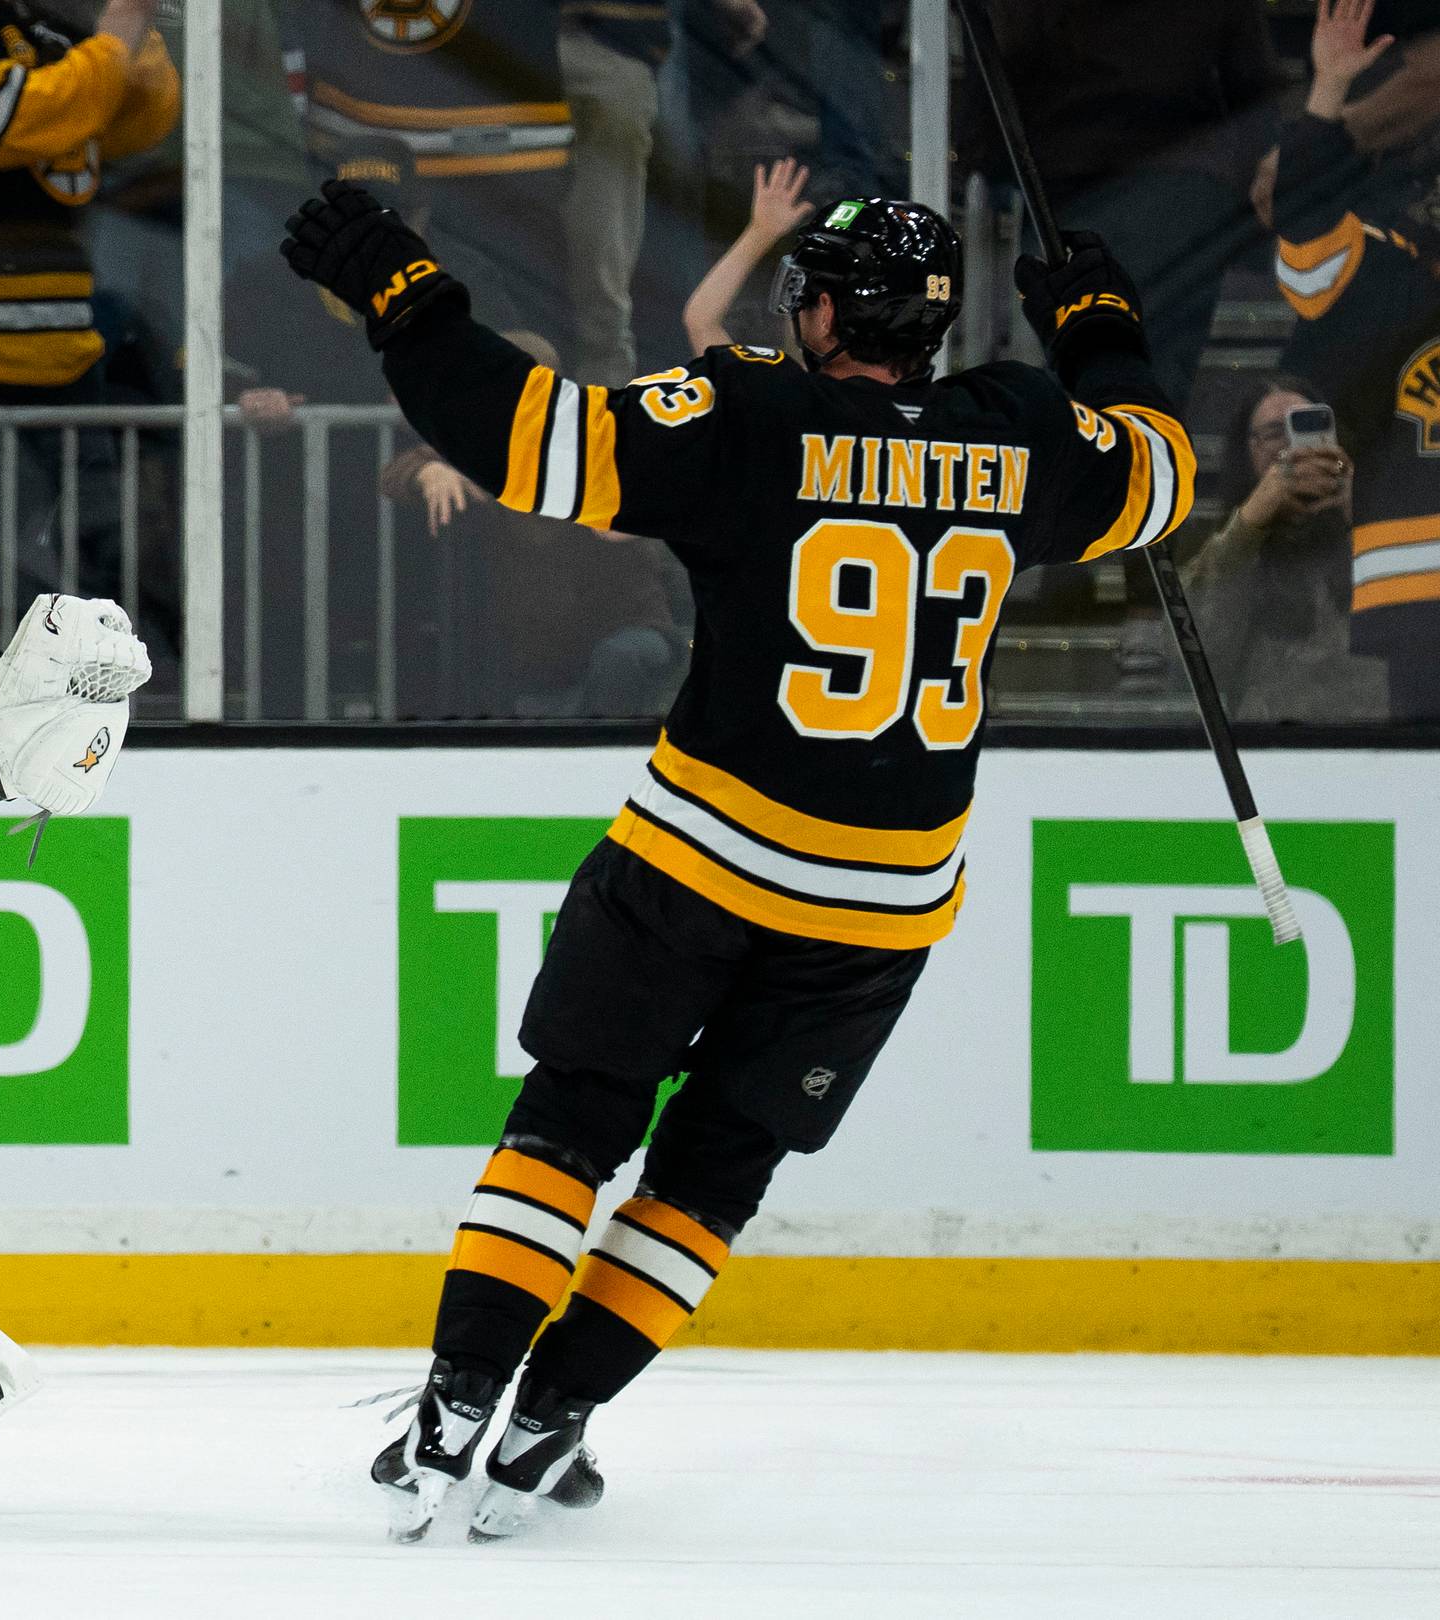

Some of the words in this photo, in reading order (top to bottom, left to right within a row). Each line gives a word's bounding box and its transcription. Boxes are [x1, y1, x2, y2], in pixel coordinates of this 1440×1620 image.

[926, 274, 951, 301] 93
[797, 434, 1030, 515] MINTEN
[777, 518, 1016, 751] 93
[433, 880, 570, 1077] T
[1067, 884, 1357, 1085] TD
[450, 1400, 483, 1419] CCM
